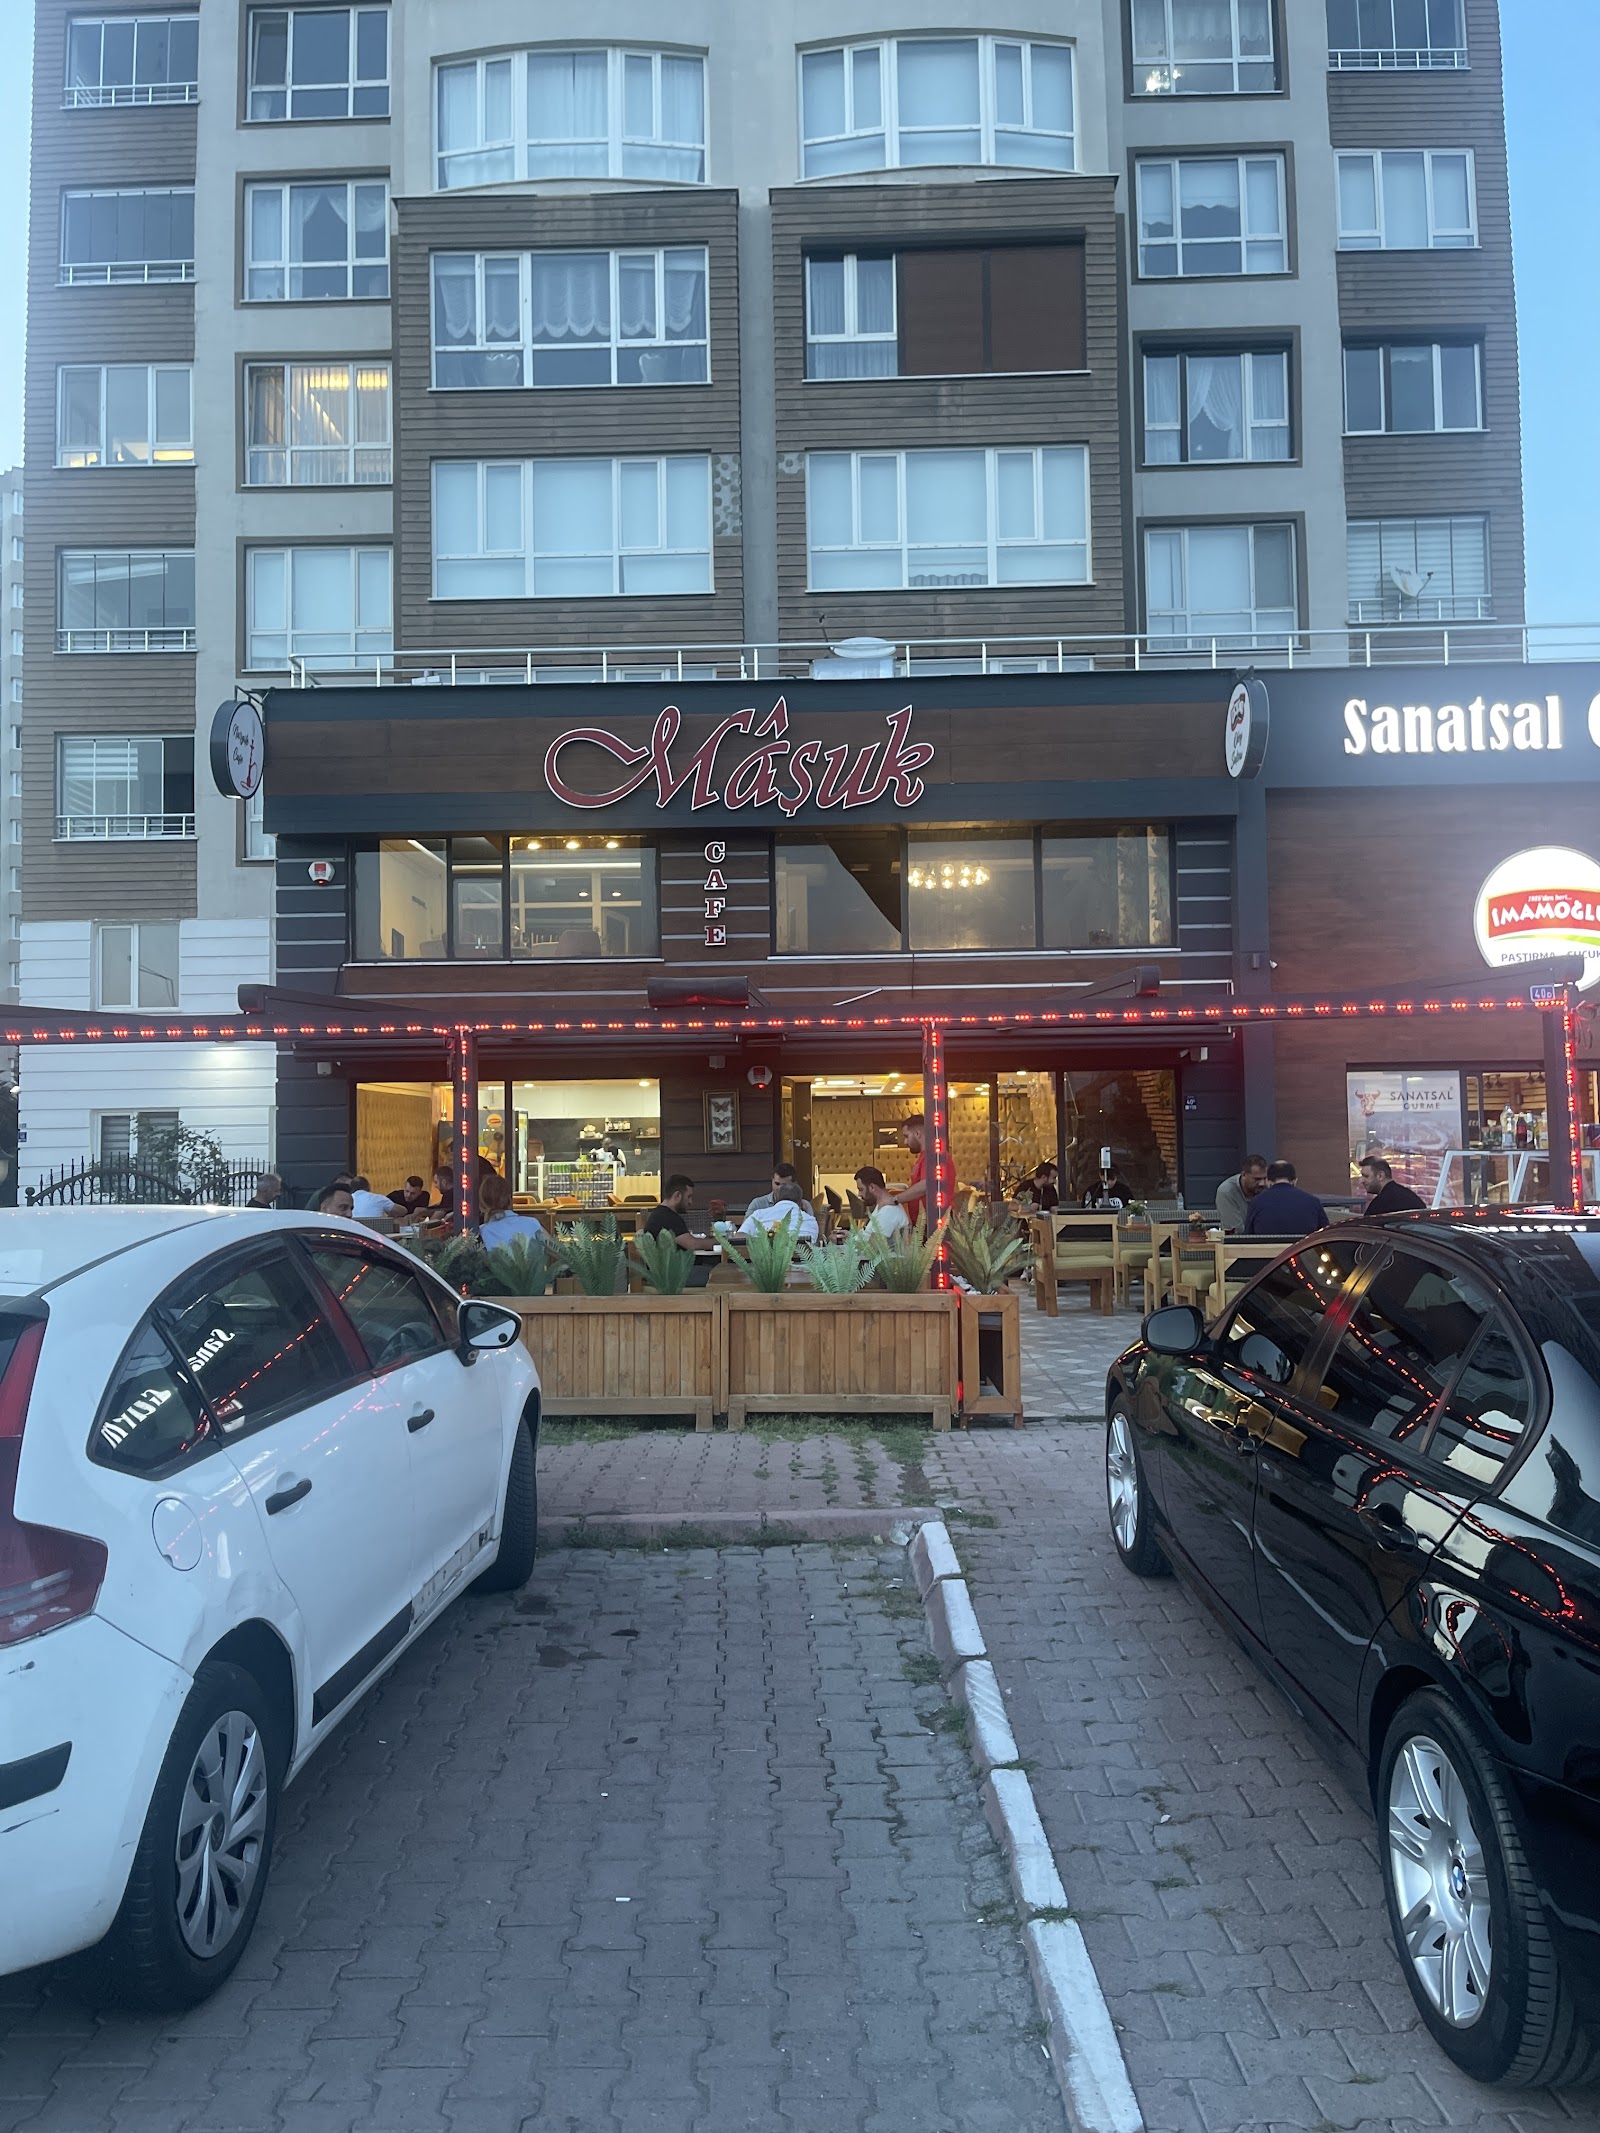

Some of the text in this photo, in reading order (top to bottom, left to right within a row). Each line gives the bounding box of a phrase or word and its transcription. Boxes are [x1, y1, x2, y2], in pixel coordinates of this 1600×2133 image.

[1343, 695, 1563, 755] Sanatsal
[704, 841, 728, 947] CAFE
[1390, 1090, 1453, 1101] SANATSAL
[1403, 1102, 1440, 1110] GURME
